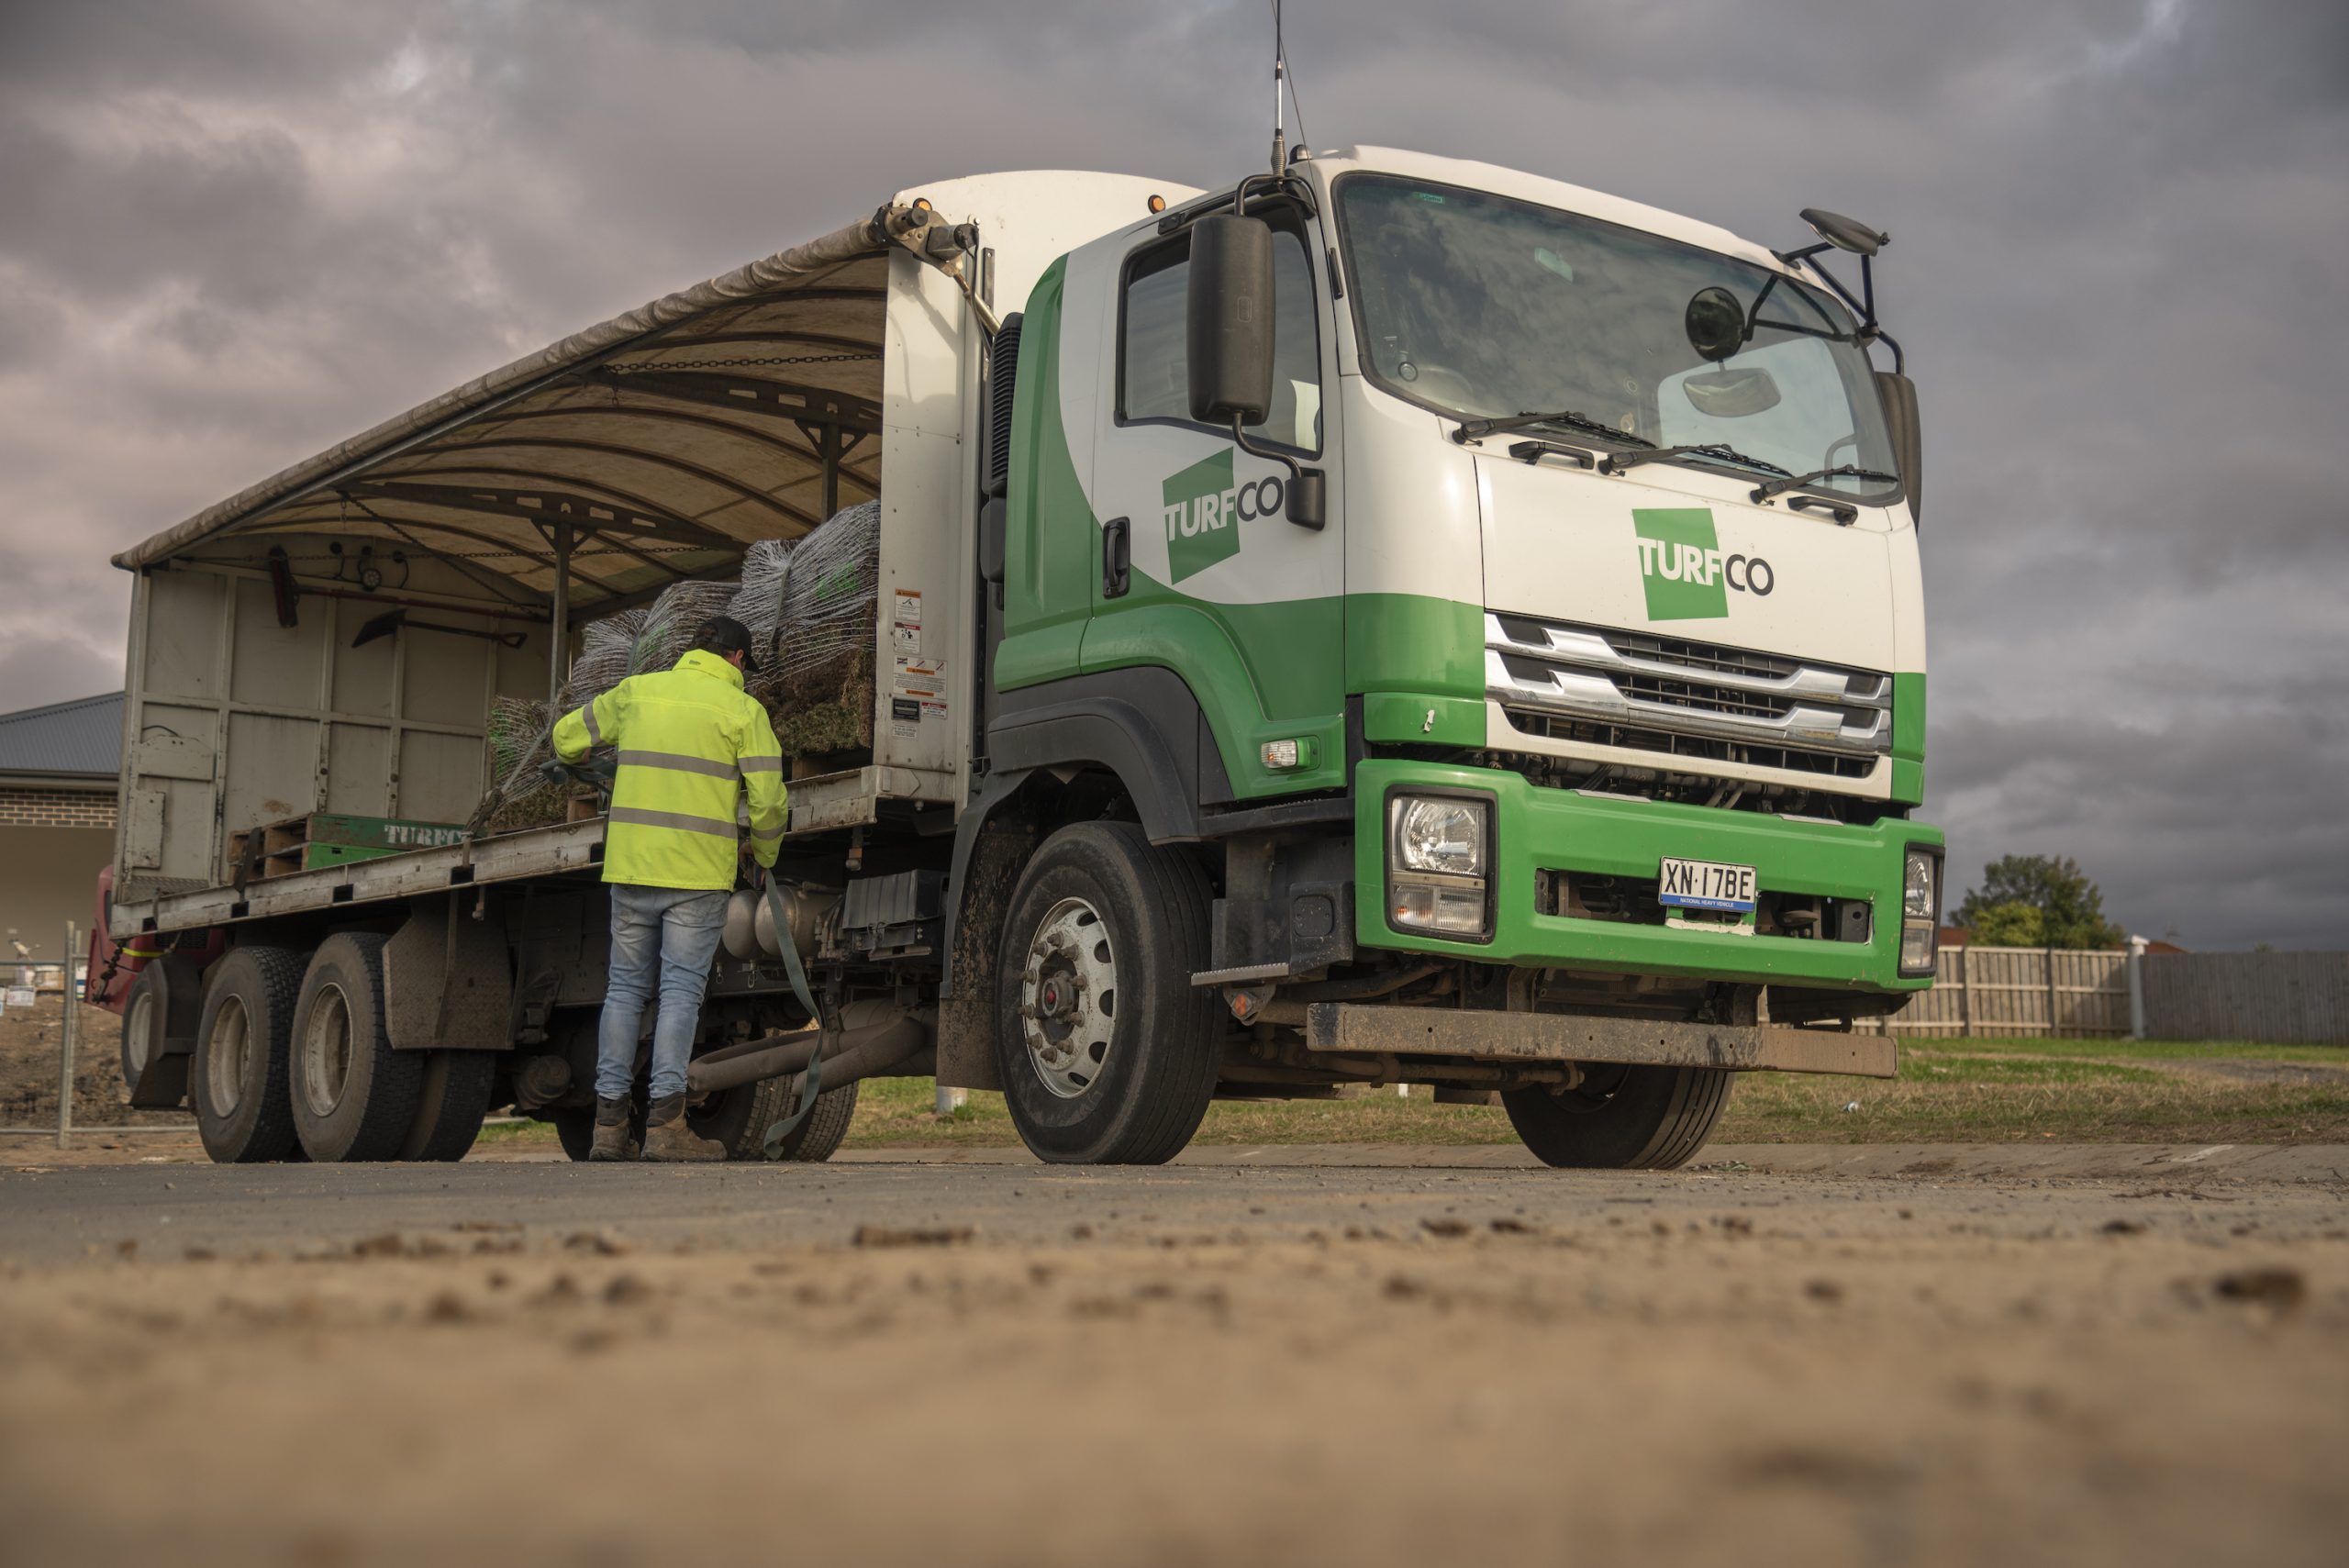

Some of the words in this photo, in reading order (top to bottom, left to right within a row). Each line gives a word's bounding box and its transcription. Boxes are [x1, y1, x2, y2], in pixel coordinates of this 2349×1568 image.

[1163, 475, 1285, 542] TURFCO
[1636, 536, 1775, 596] TURFCO
[384, 824, 468, 846] TURFC
